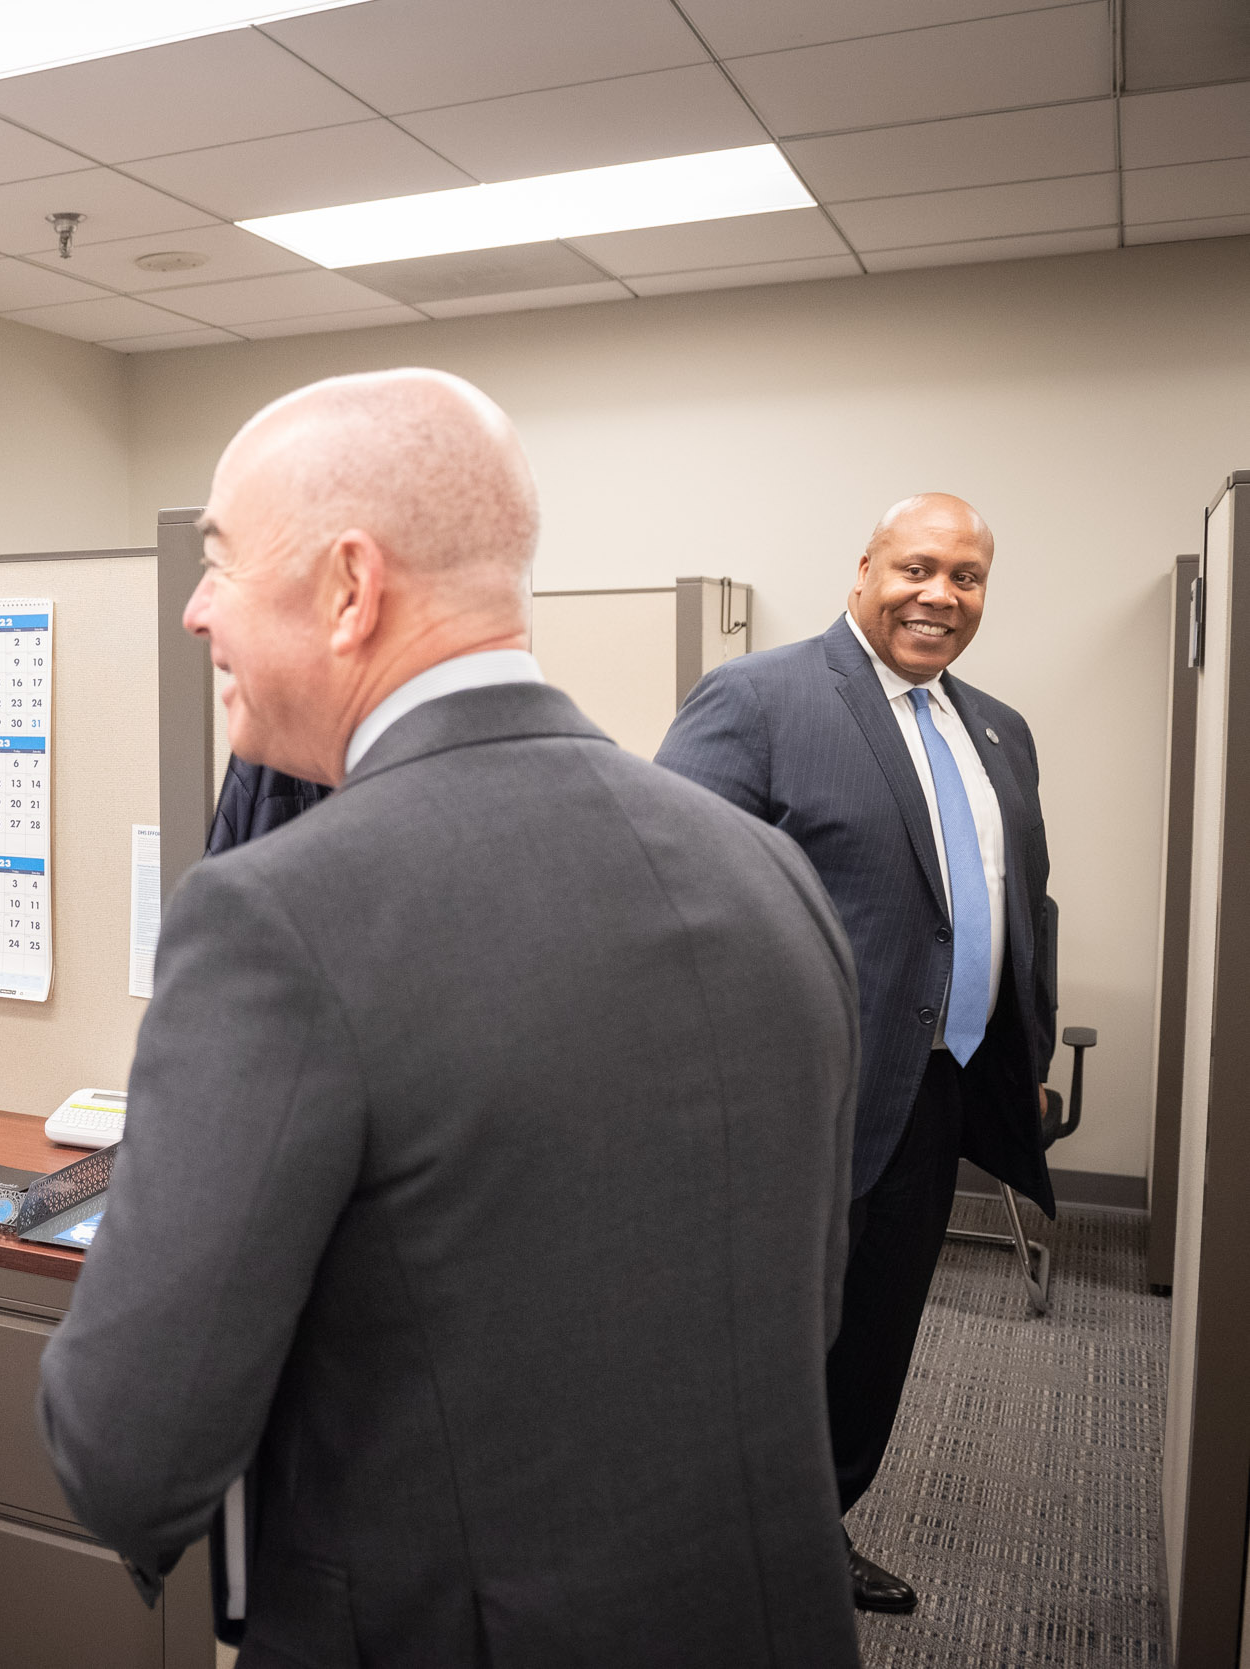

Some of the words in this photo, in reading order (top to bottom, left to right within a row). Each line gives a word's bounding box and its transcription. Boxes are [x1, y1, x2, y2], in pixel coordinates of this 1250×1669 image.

[14, 638, 20, 646] 2
[35, 637, 41, 646] 3
[13, 658, 20, 667] 9
[33, 658, 43, 667] 10
[12, 678, 23, 687] 16
[33, 678, 43, 687] 17
[11, 698, 23, 708] 23
[32, 698, 42, 707] 24
[11, 719, 23, 728] 30
[31, 719, 41, 728] 31
[13, 759, 19, 768] 6
[33, 759, 39, 768] 7
[11, 779, 22, 788] 13
[31, 780, 41, 788] 14
[10, 799, 22, 808] 20
[30, 800, 40, 809] 21
[10, 819, 21, 828] 27
[30, 820, 41, 830] 28
[12, 879, 18, 888] 3
[10, 899, 21, 908] 10
[31, 901, 39, 910] 11
[10, 919, 20, 928] 17
[30, 921, 40, 930] 18
[8, 939, 20, 948] 24
[29, 941, 40, 950] 25
